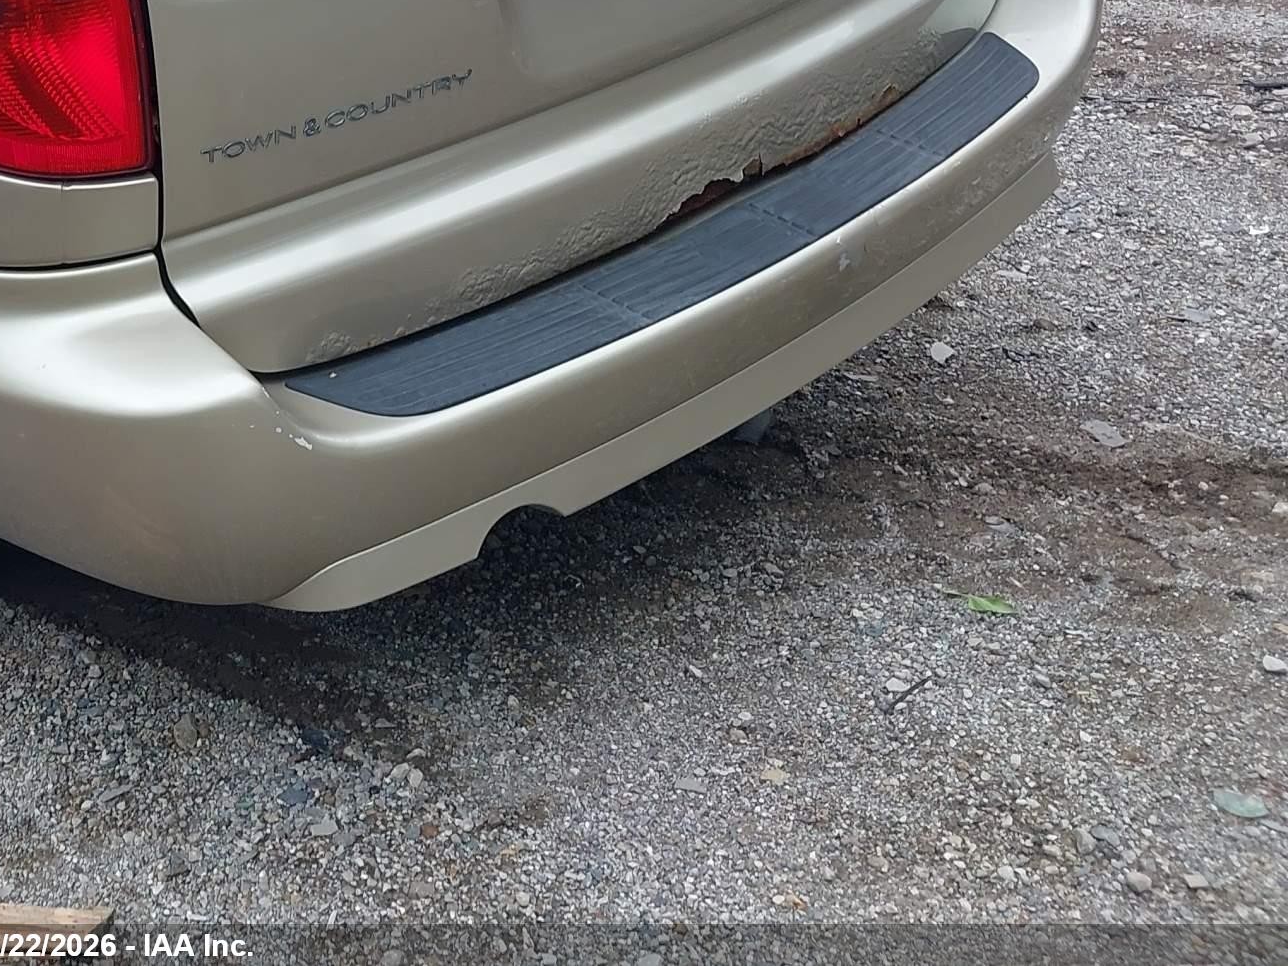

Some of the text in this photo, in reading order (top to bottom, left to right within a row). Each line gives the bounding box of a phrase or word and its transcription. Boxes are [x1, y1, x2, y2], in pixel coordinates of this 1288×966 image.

[200, 68, 473, 162] TOWN & COUNTRY
